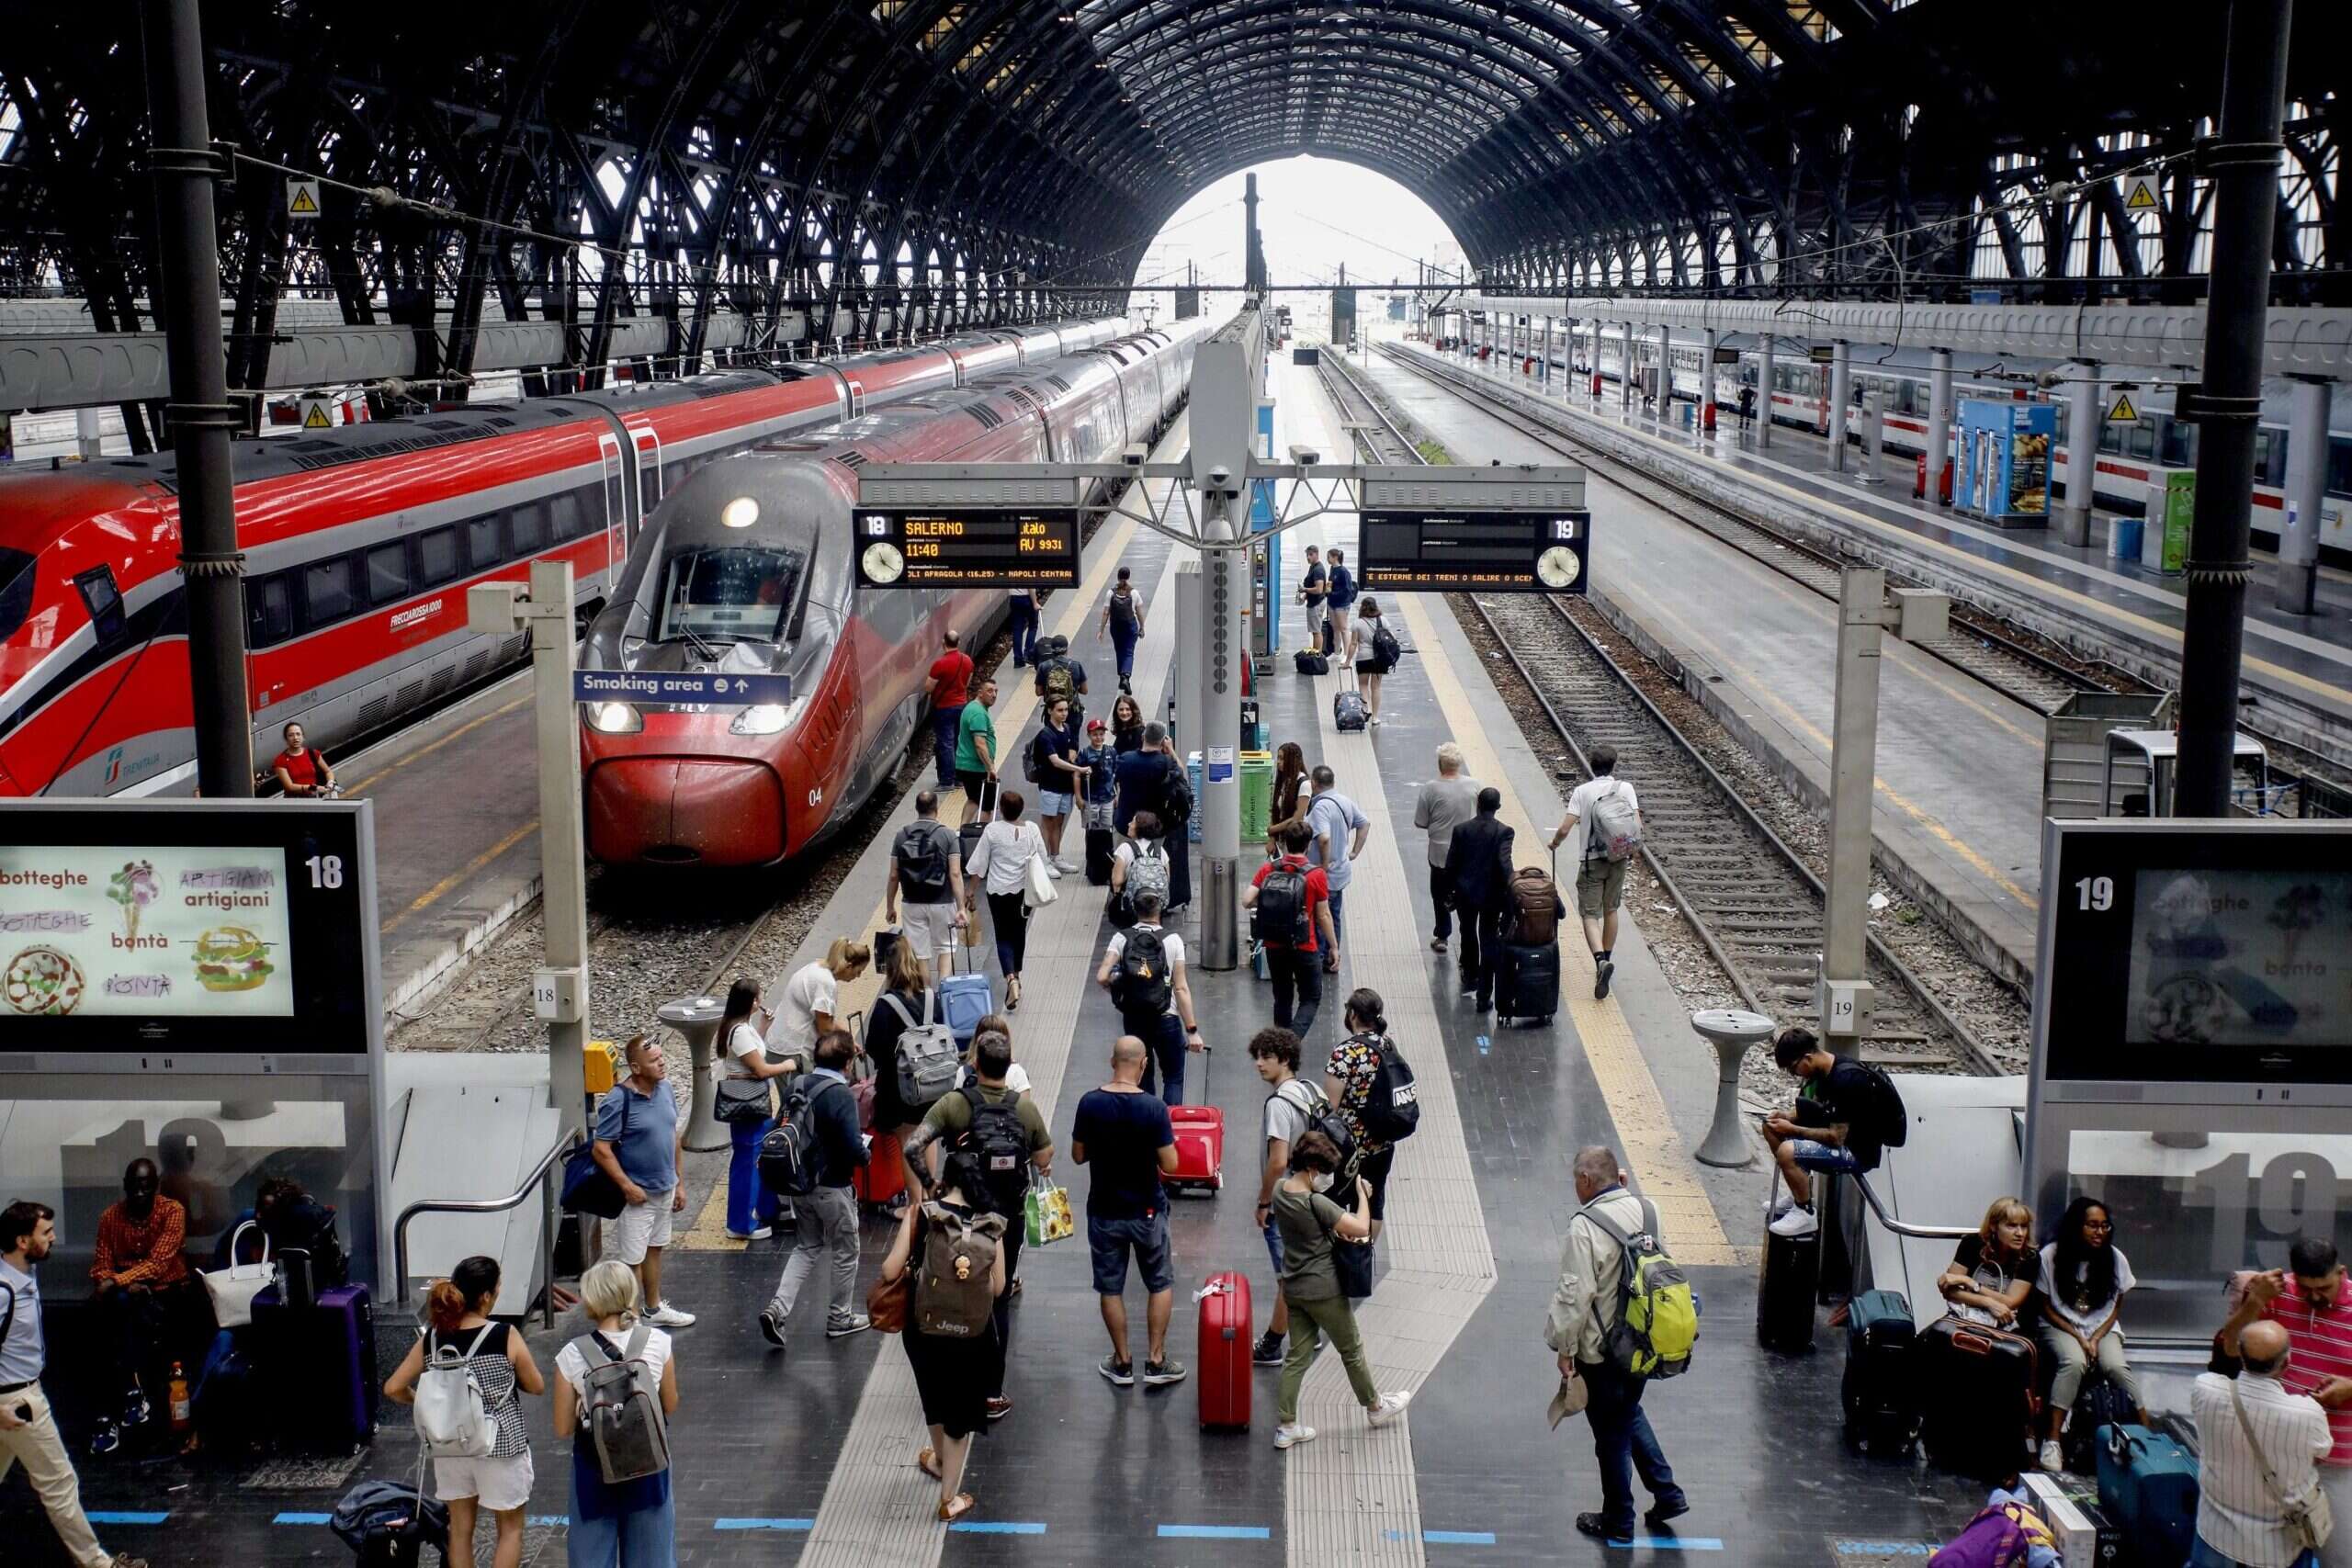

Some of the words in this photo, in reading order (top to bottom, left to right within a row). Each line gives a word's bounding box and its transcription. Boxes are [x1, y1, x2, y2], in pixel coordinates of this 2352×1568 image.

[866, 516, 885, 535] 18
[905, 522, 963, 536] SALERNO
[1555, 520, 1574, 539] 19
[906, 544, 938, 557] 11:40
[1020, 540, 1035, 552] AV
[1039, 540, 1062, 550] 9931
[924, 570, 963, 579] AFRAGOLA
[967, 570, 995, 579] (16.25)
[1009, 570, 1036, 579] NAPOLI
[1472, 573, 1500, 581] SALIRE
[582, 675, 659, 697] Smoking
[663, 681, 704, 692] area
[808, 787, 822, 807] 04
[0, 868, 88, 890] botteghe
[305, 855, 343, 889] 18
[185, 890, 269, 911] artigiani
[2075, 876, 2114, 910] 19
[111, 931, 169, 949] bontà
[537, 988, 554, 1002] 18
[1835, 1002, 1852, 1015] 19
[936, 1321, 969, 1335] Jeep
